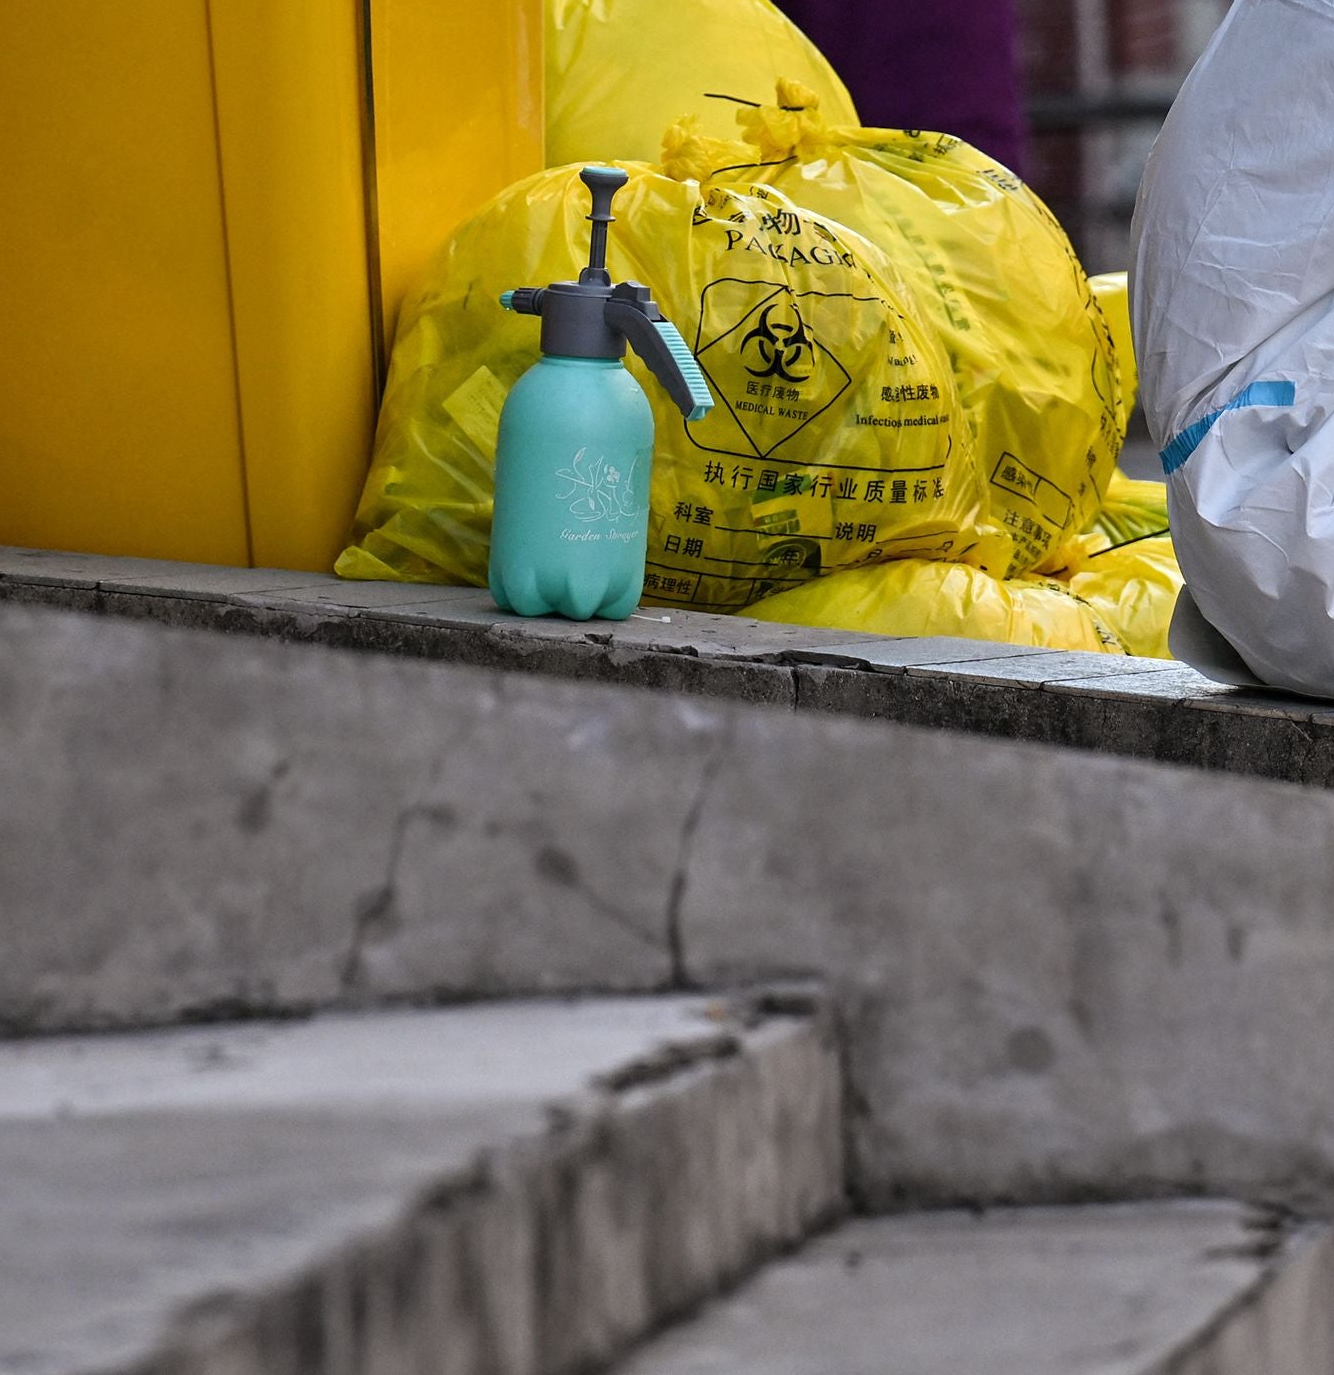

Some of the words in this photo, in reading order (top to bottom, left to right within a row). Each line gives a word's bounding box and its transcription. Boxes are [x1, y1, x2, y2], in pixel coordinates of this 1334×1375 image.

[747, 381, 800, 402] 医疗废物
[735, 400, 775, 416] MEDICAL
[778, 407, 809, 420] WASTE
[903, 414, 939, 427] medical
[704, 460, 945, 504] 执行国家行业质量标准
[674, 502, 714, 526] 科室
[560, 529, 600, 541] Garden
[835, 522, 876, 542] 说明
[665, 534, 703, 558] 日期
[644, 574, 692, 595] 病理性
